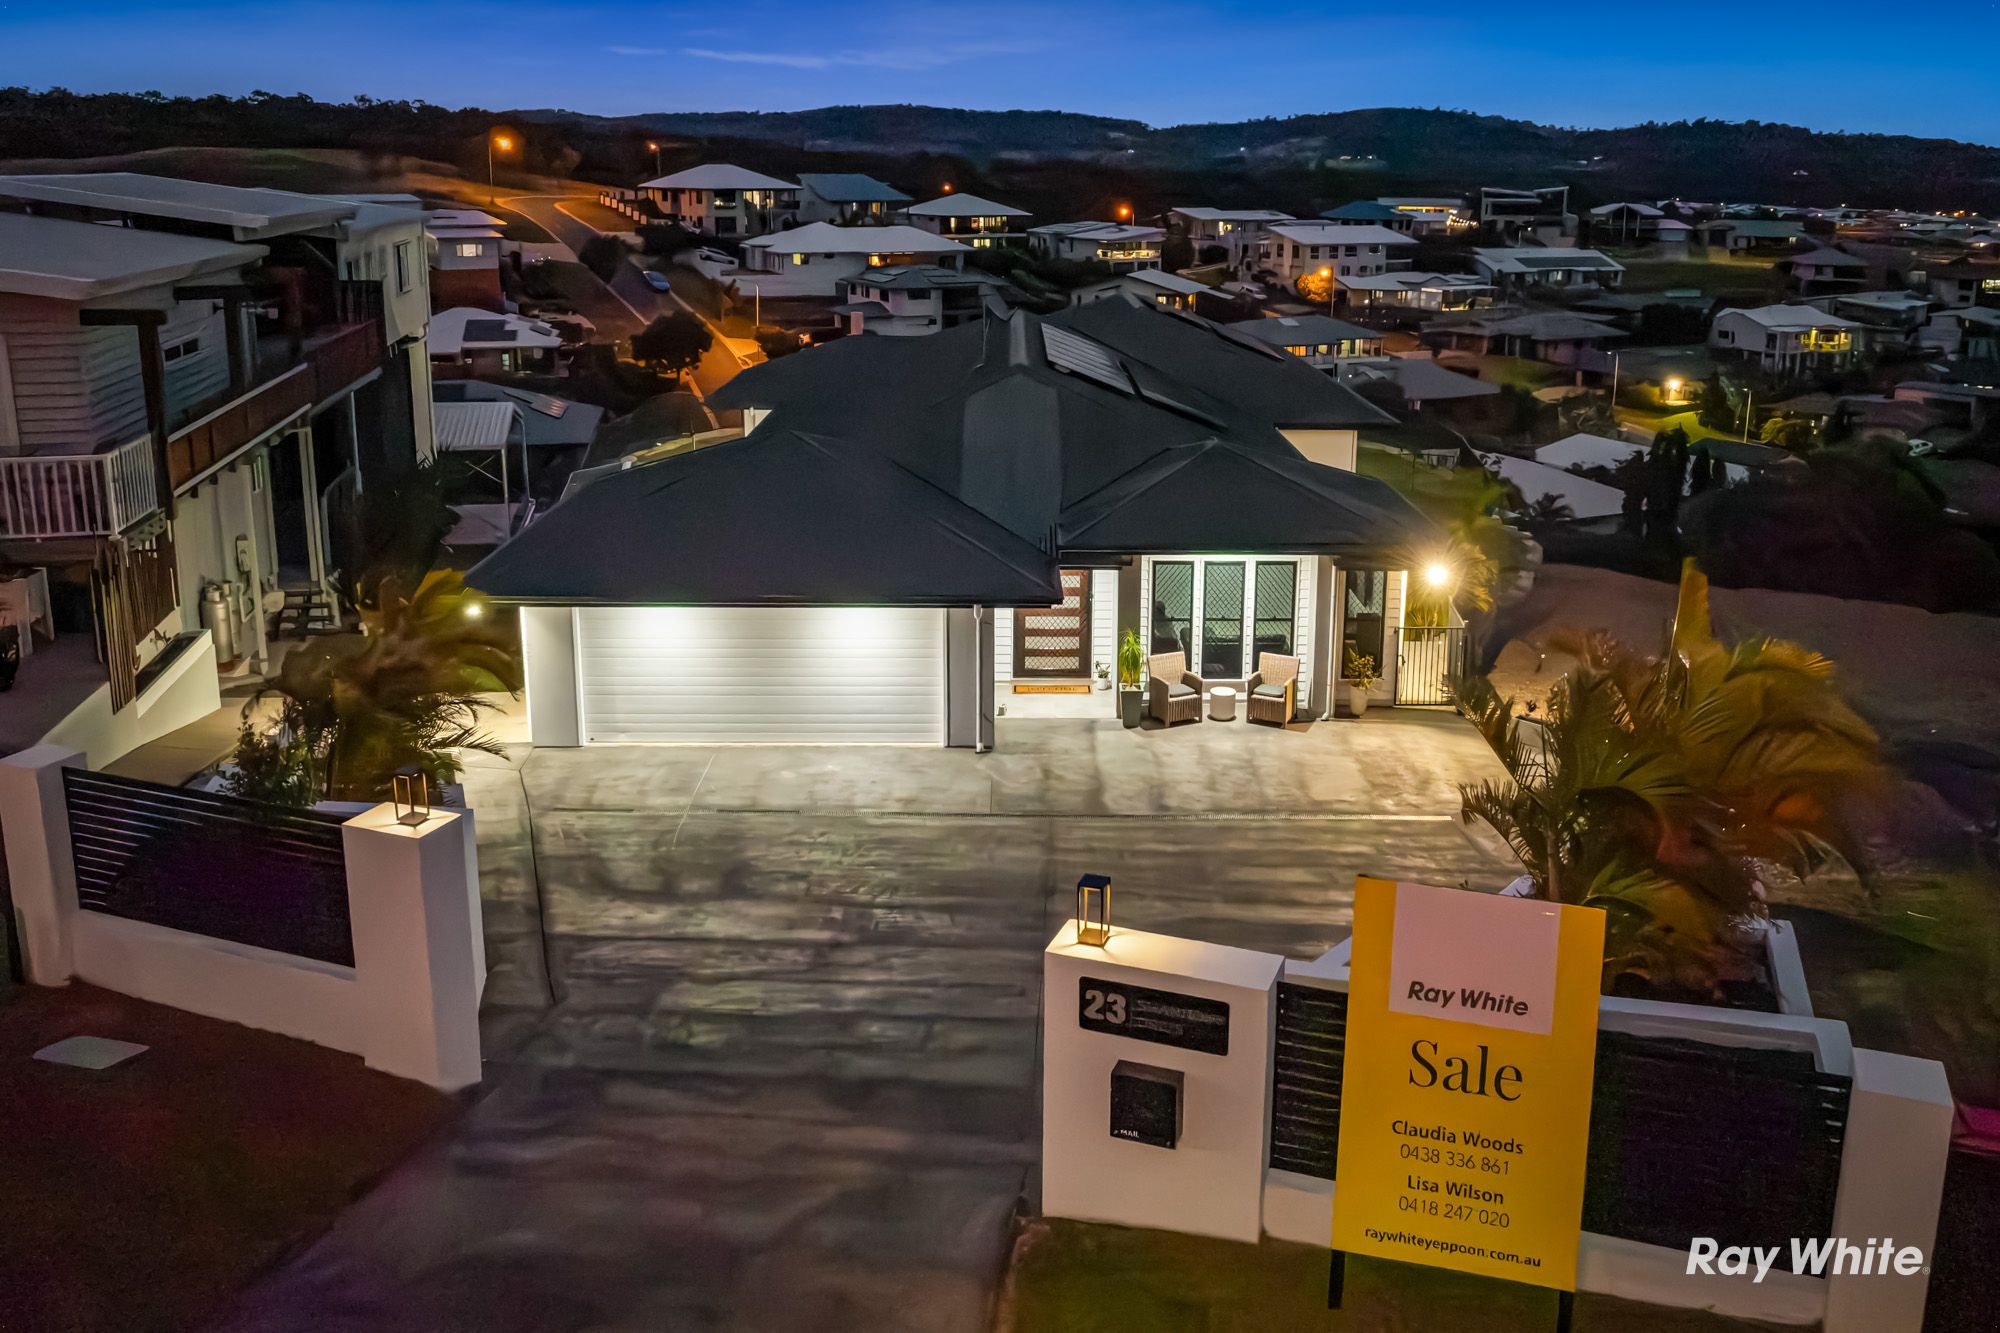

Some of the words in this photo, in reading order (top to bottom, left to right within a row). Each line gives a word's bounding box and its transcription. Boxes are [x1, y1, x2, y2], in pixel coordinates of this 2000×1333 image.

[1083, 989, 1127, 1025] 23
[1407, 980, 1455, 1009] Ray
[1460, 988, 1529, 1016] White
[1408, 1039, 1523, 1101] Sale
[1120, 1129, 1140, 1138] MAIL
[1391, 1120, 1457, 1145] Claudia
[1462, 1130, 1524, 1155] Woods
[1400, 1143, 1441, 1164] 0438
[1446, 1151, 1477, 1170] 336
[1480, 1157, 1510, 1176] 861
[1407, 1174, 1440, 1193] Lisa
[1445, 1180, 1504, 1205] Wilson
[1398, 1196, 1439, 1216] 0418
[1443, 1203, 1474, 1222] 247
[1478, 1209, 1511, 1229] 020
[1364, 1227, 1542, 1268] raywhiteyeppoon.com.au
